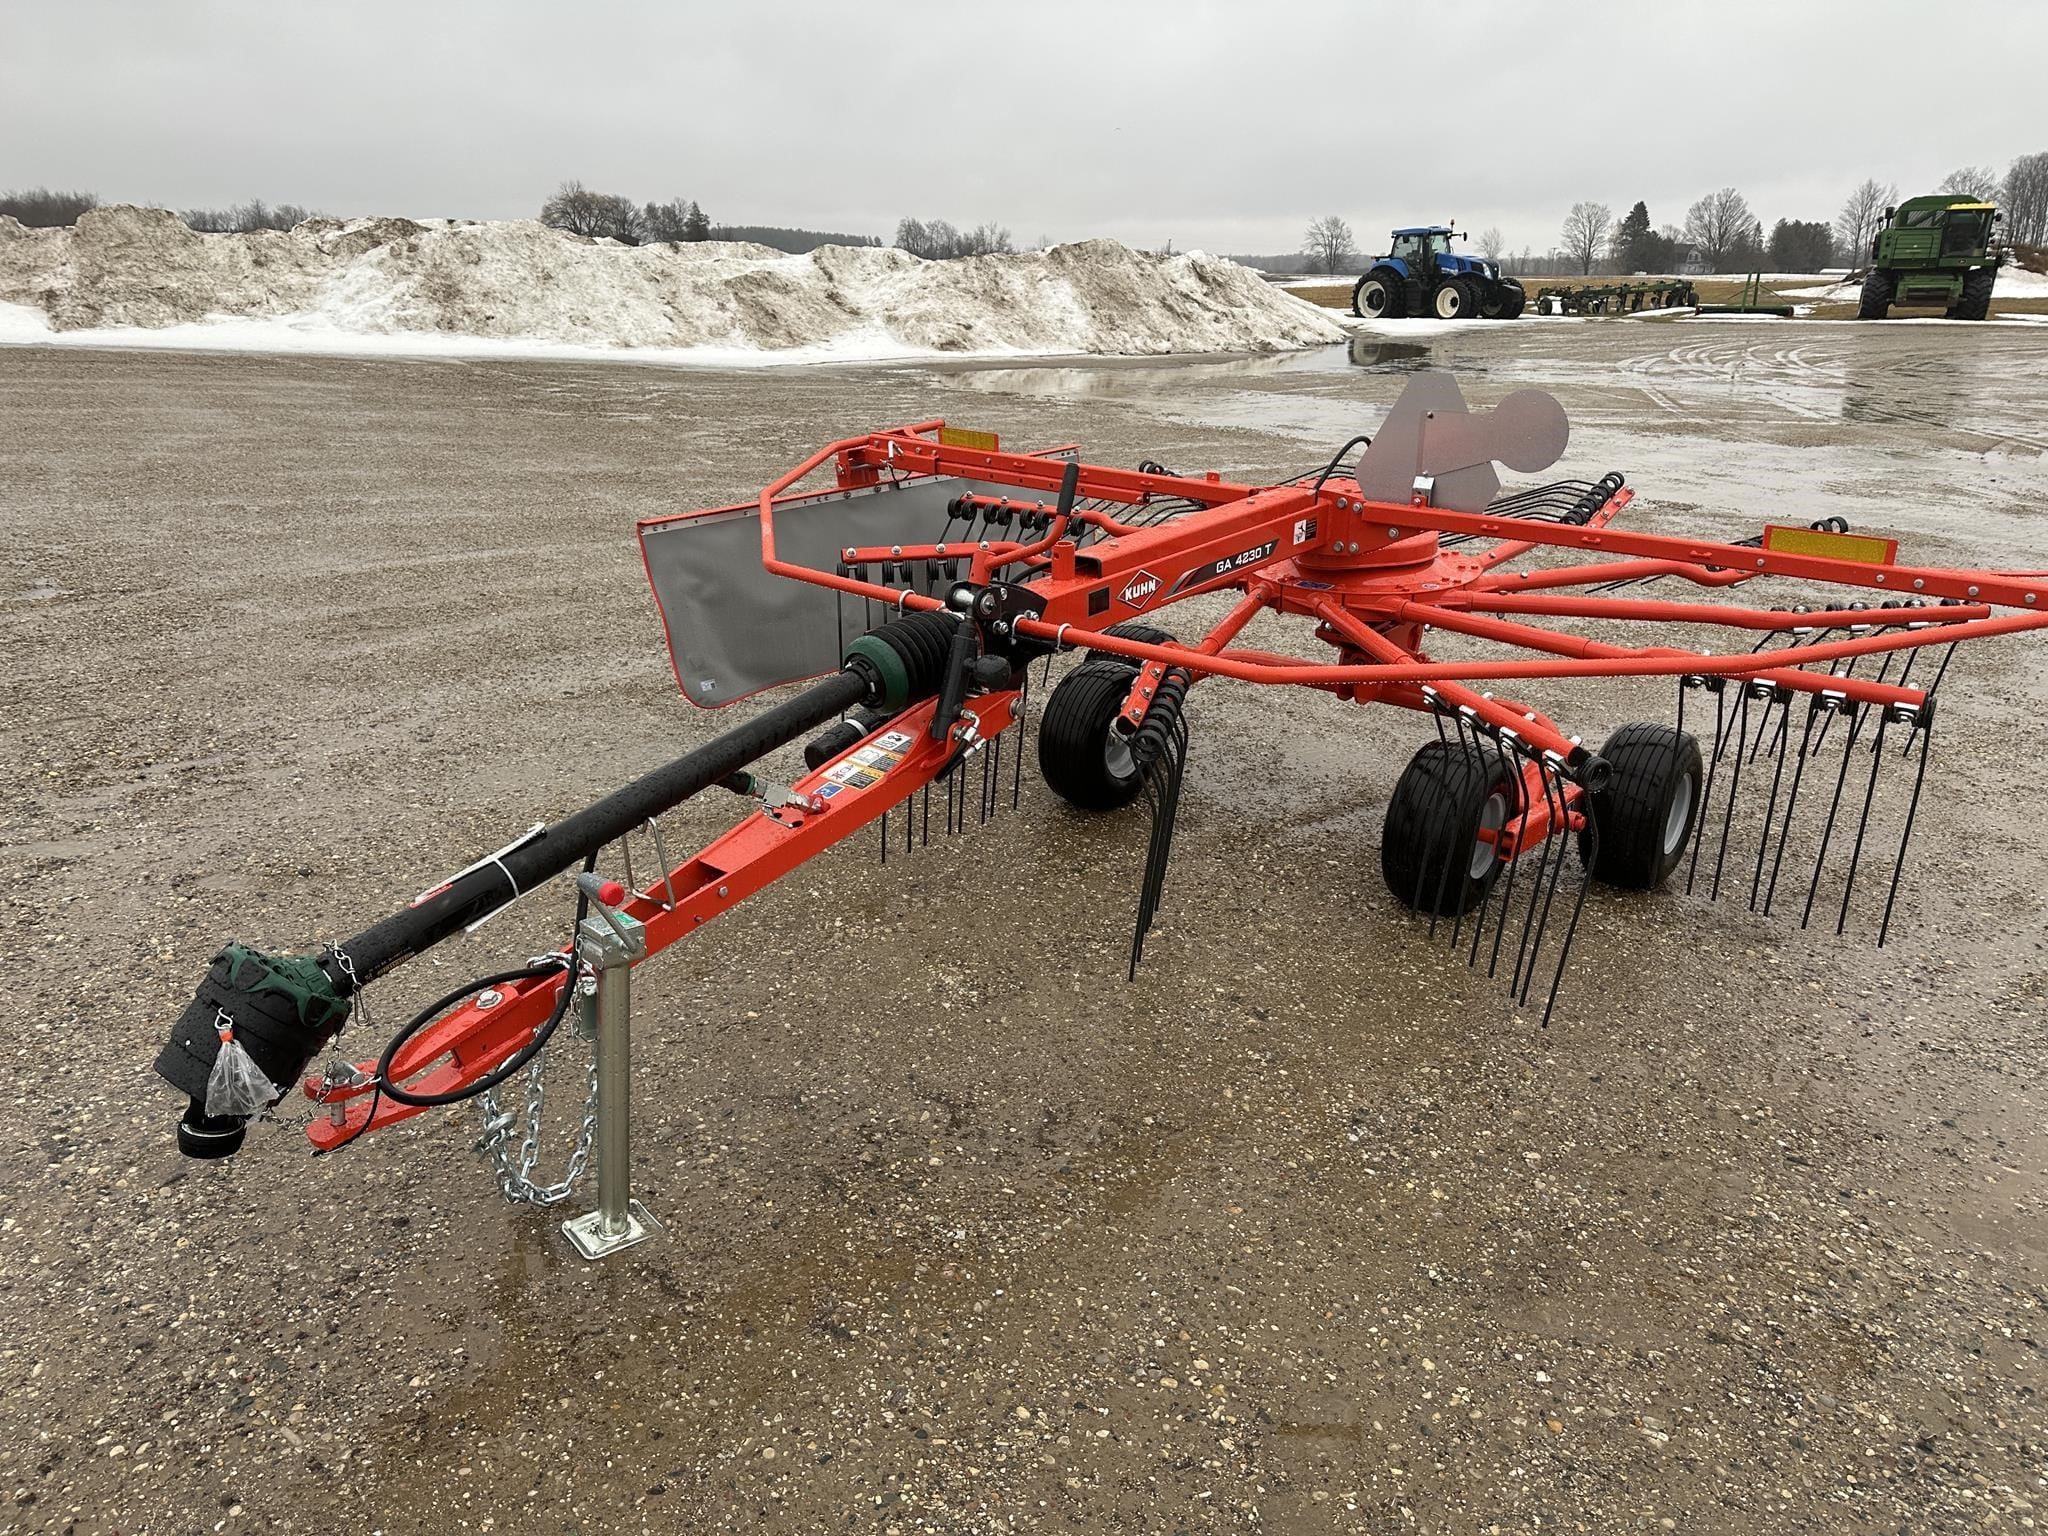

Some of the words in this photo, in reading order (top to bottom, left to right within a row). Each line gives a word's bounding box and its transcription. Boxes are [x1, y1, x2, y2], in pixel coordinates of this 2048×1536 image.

[1216, 559, 1232, 574] GA
[1235, 547, 1262, 566] 4230
[1264, 543, 1273, 555] T
[1125, 579, 1156, 601] KUHN
